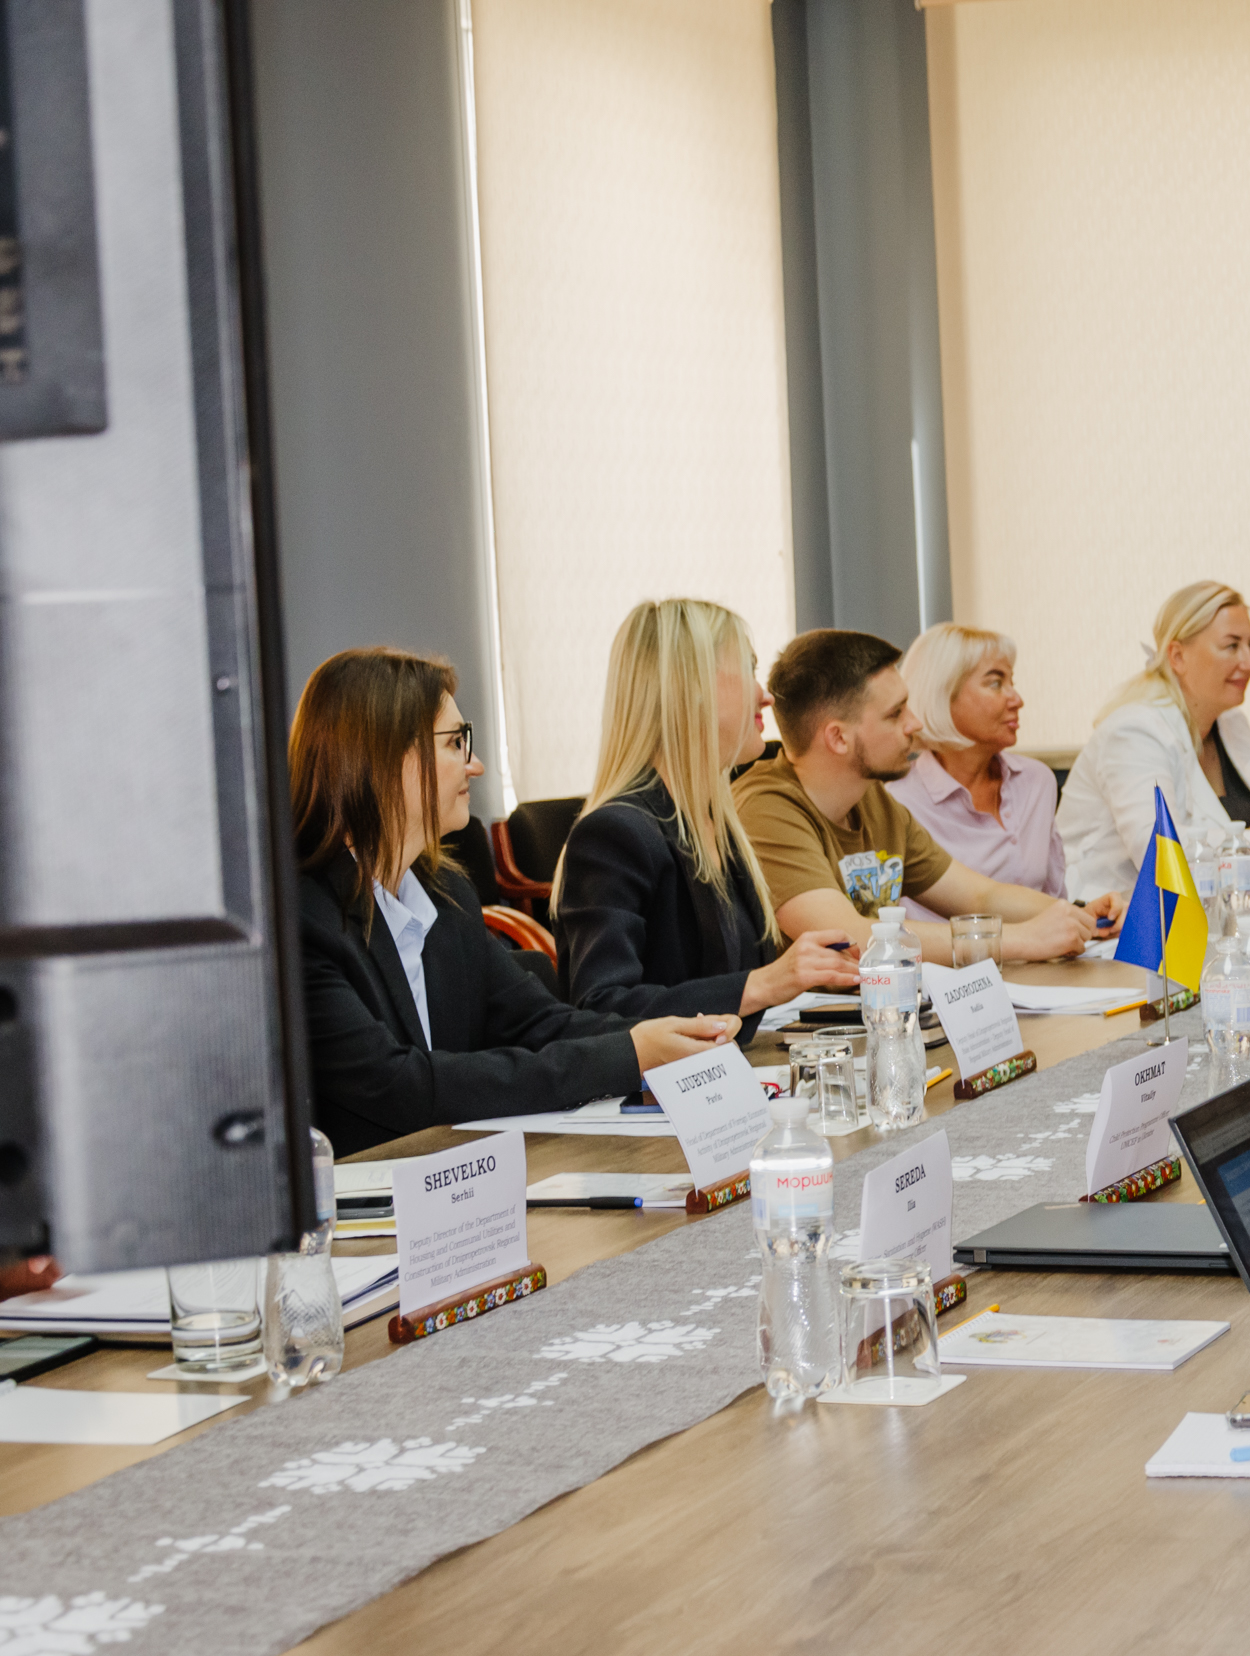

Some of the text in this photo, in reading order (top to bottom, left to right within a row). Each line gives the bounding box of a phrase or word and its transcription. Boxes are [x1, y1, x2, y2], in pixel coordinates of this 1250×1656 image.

[944, 976, 993, 1004] ZADOROZHNA
[676, 1063, 727, 1093] LIUBYMOV
[1134, 1061, 1166, 1087] OKHMAT
[424, 1155, 496, 1193] SHEVELKO
[895, 1164, 926, 1194] SEREDA
[451, 1187, 475, 1204] Serhii
[409, 1236, 432, 1250] Deputy
[433, 1227, 457, 1242] Director
[458, 1222, 465, 1233] of
[475, 1208, 509, 1227] Department
[510, 1203, 516, 1215] of
[409, 1250, 435, 1265] Housing
[436, 1243, 448, 1256] and
[448, 1231, 481, 1251] Communal
[504, 1218, 516, 1231] and
[404, 1231, 520, 1282] Construction of Dnipropetrovsk Regional
[430, 1257, 497, 1288] Military Administration
